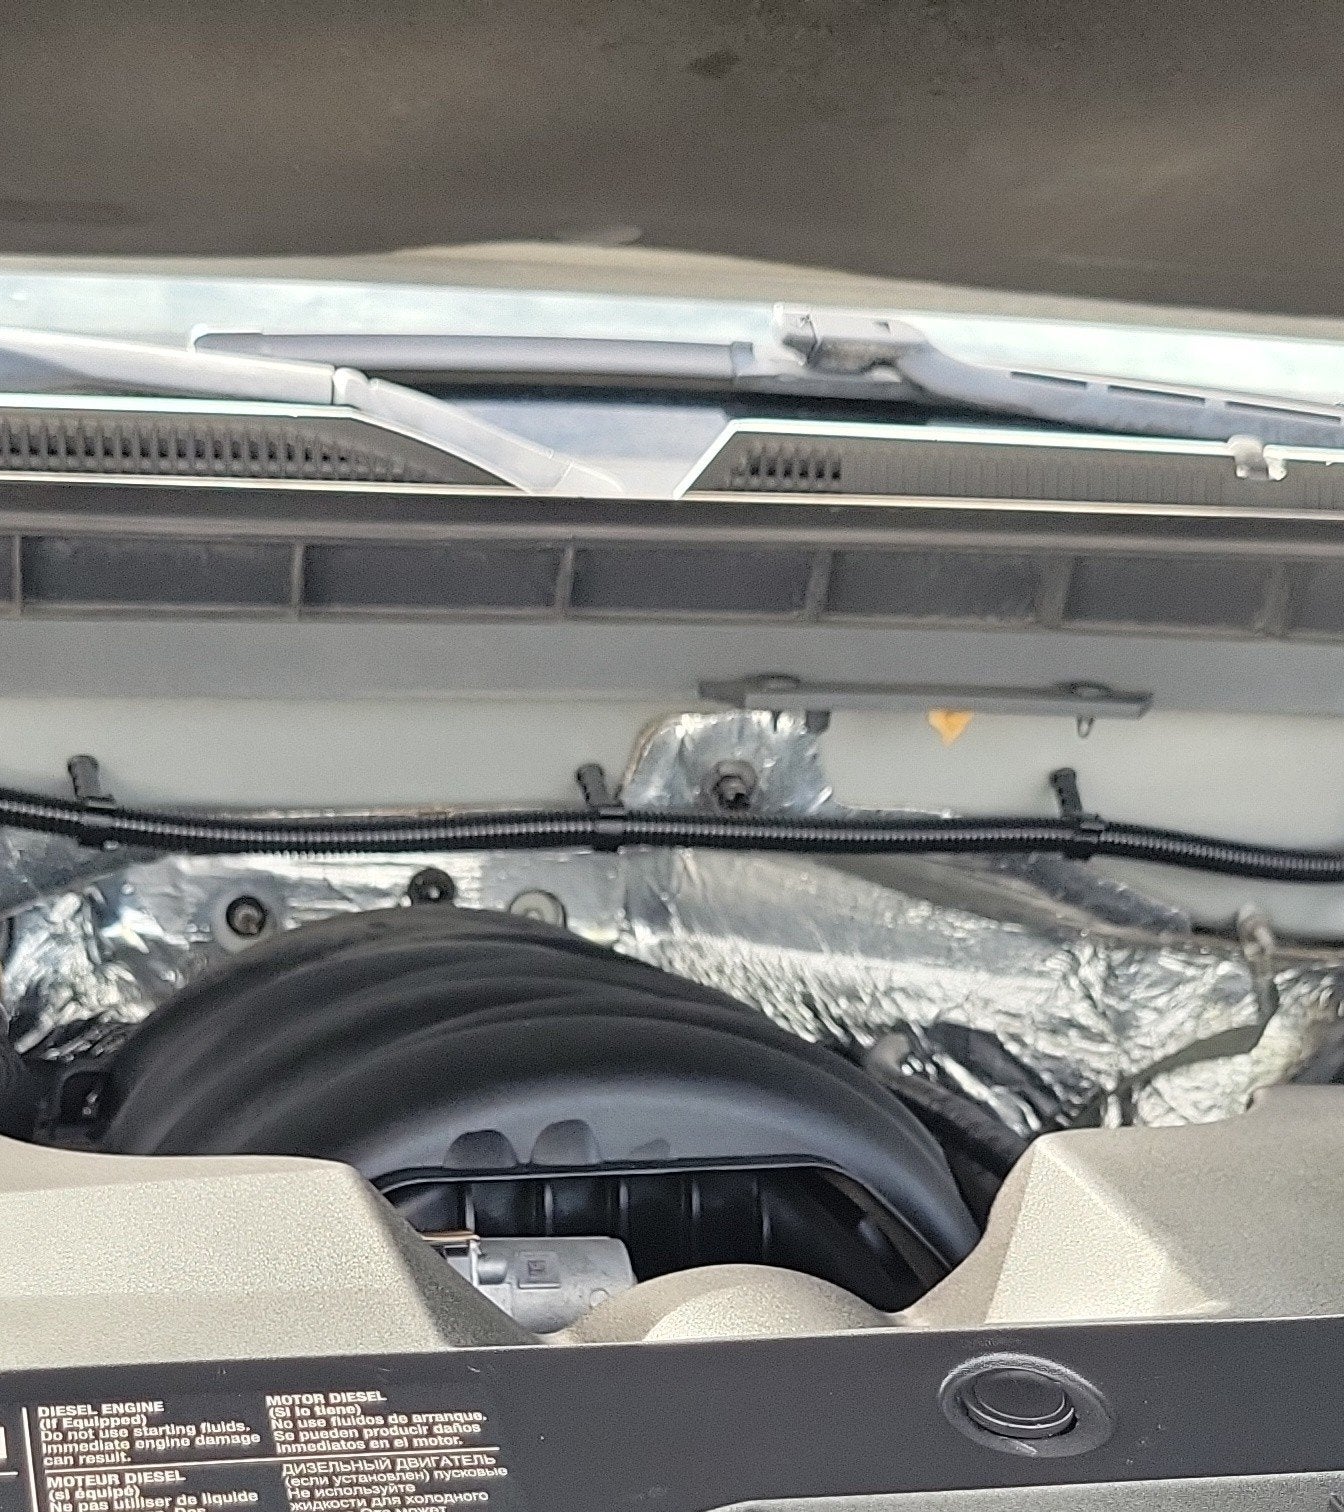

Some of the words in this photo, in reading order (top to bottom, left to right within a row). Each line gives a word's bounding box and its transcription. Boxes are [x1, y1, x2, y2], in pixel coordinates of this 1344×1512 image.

[265, 1393, 326, 1407] MOTOR
[328, 1390, 387, 1403] DIESEL
[38, 1404, 98, 1418] DIESEL
[101, 1401, 165, 1414] ENGINE
[295, 1405, 311, 1417] lo
[314, 1403, 362, 1417] tiene)
[62, 1414, 148, 1429] Equipped)
[270, 1418, 294, 1431] No
[298, 1417, 326, 1428] use
[330, 1412, 385, 1427] fluidos
[388, 1413, 409, 1424] de
[412, 1411, 487, 1425] arranque.
[40, 1430, 63, 1442] Do
[68, 1428, 95, 1440] not
[99, 1428, 129, 1439] use
[133, 1423, 196, 1437] starting
[200, 1421, 251, 1434] fluids.
[273, 1430, 294, 1442] Se
[299, 1427, 359, 1442] pueden
[363, 1424, 429, 1439] producir
[432, 1421, 481, 1434] daños
[42, 1439, 130, 1454] Immediate
[135, 1437, 191, 1450] engine
[195, 1432, 261, 1447] damage
[369, 1438, 390, 1449] en
[394, 1436, 409, 1448] el
[412, 1435, 463, 1447] motor.
[43, 1455, 74, 1466] can
[78, 1452, 132, 1465] result.
[281, 1458, 392, 1477] ДИЗЕЛЬНЫЙ
[395, 1454, 496, 1471] ДВИГАТЕЛЬ
[47, 1474, 120, 1489] MOTEUR
[124, 1469, 186, 1484] DIESEL
[285, 1475, 329, 1489] (если
[332, 1470, 430, 1487] установлен)
[433, 1466, 508, 1482] пусковые
[48, 1488, 70, 1502] (si
[75, 1485, 140, 1501] équipé)
[113, 1495, 172, 1510] utiliser
[176, 1492, 198, 1505] de
[202, 1490, 259, 1506] liquide
[287, 1486, 310, 1500] Не
[314, 1482, 416, 1499] используйте
[290, 1498, 367, 1512] жидкости
[370, 1496, 401, 1508] для
[405, 1491, 489, 1505] холодного
